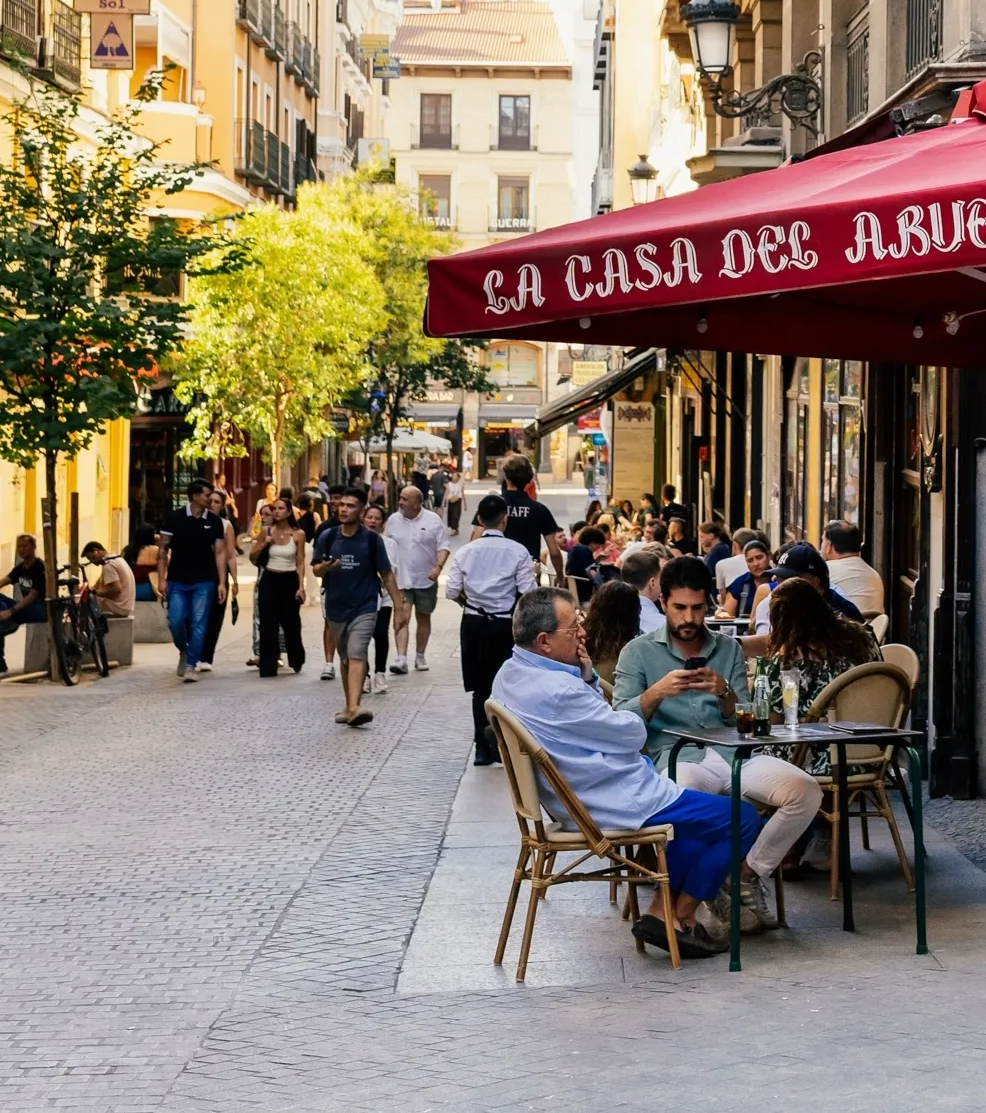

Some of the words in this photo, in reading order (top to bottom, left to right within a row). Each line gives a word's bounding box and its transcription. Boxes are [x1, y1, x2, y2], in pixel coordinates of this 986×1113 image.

[483, 263, 546, 315] LA
[565, 237, 703, 302] CASA
[719, 220, 818, 279] DEL
[507, 506, 530, 518] TAFF
